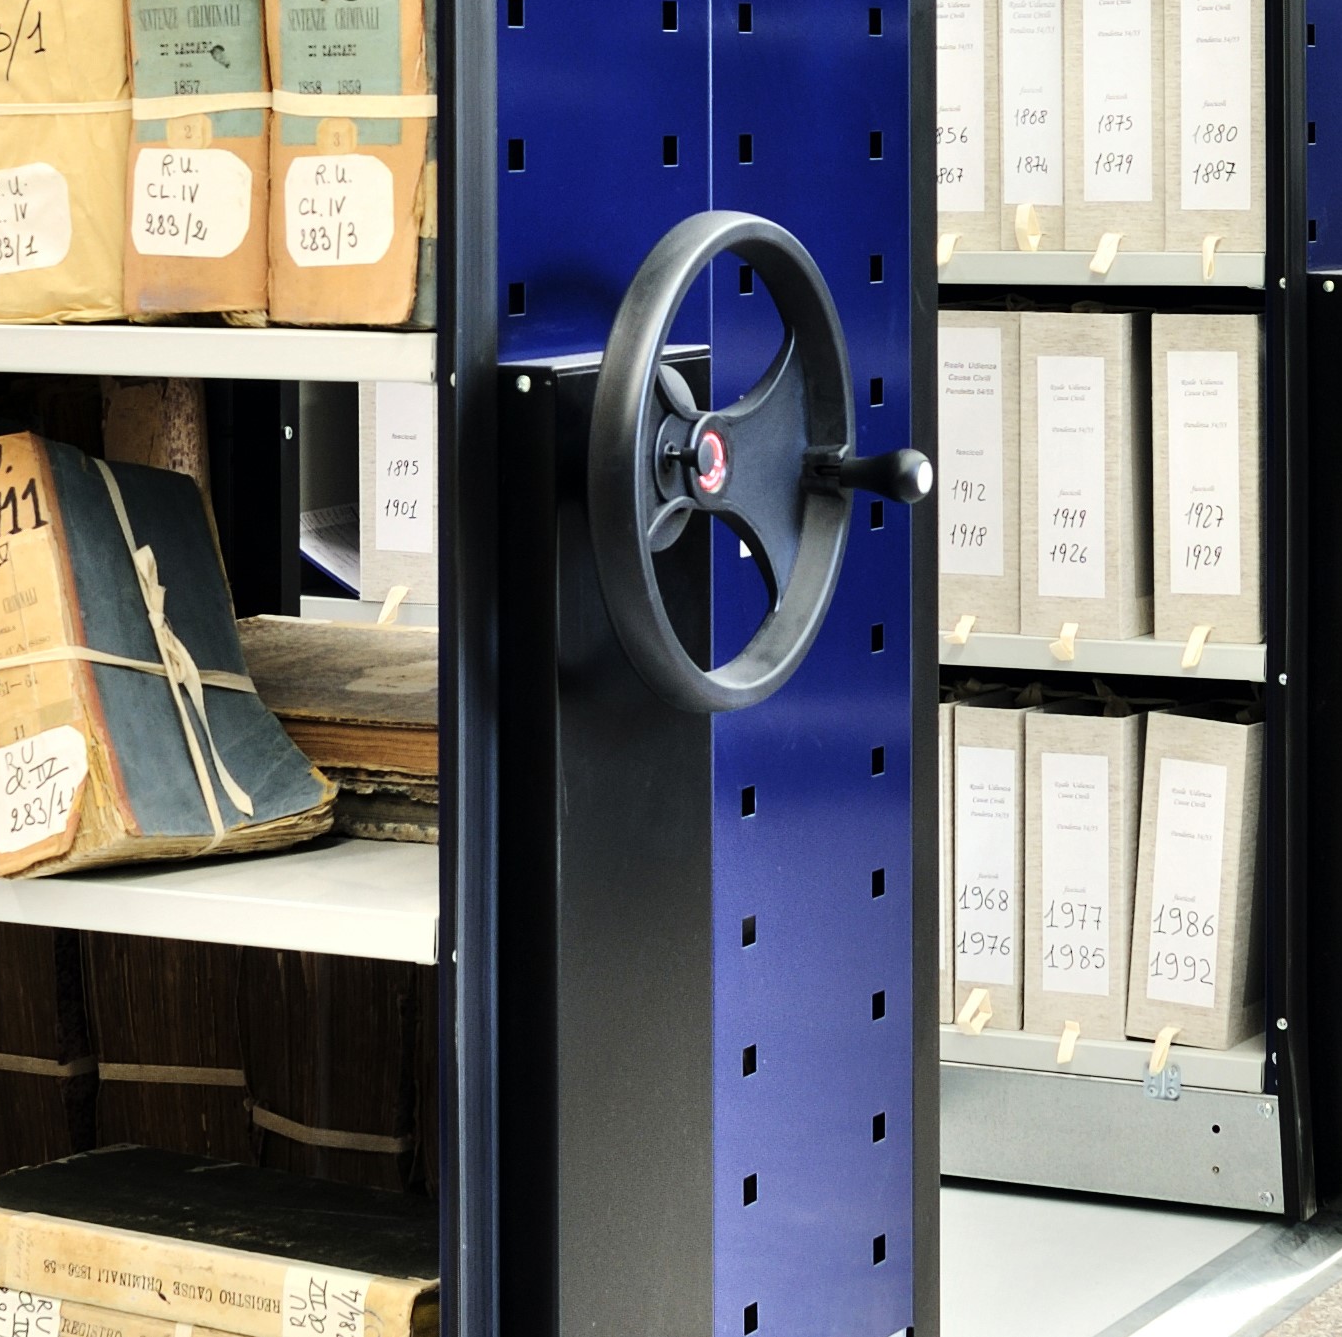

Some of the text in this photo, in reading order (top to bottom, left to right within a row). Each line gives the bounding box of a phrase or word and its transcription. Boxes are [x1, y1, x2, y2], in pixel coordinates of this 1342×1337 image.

[173, 81, 199, 95] 1857
[299, 79, 361, 94] 1858 1859
[1015, 108, 1047, 125] 1868
[1098, 115, 1132, 133] 1875
[1193, 124, 1237, 144] 1880
[1017, 156, 1047, 173] 1874
[1095, 153, 1133, 174] 1879
[1193, 161, 1237, 184] 1887
[145, 209, 207, 241] 283/2
[300, 222, 358, 259] 283/3
[387, 458, 419, 478] 1895
[952, 479, 986, 502] 1912
[384, 499, 418, 519] 1901
[1053, 508, 1086, 528] 1919
[1185, 502, 1224, 528] 1927
[950, 524, 987, 546] 1918
[1050, 543, 1087, 563] 1926
[1186, 546, 1222, 570] 1929
[958, 884, 1008, 911] 1968
[1044, 900, 1103, 931] 1977
[1153, 903, 1214, 937] 1986
[957, 930, 1010, 955] 1976
[1044, 944, 1105, 970] 1985
[1151, 951, 1213, 985] 1992
[97, 1269, 161, 1293] CRIMINALI
[172, 1282, 213, 1302] CAUSE
[219, 1287, 281, 1314] REGISTRO
